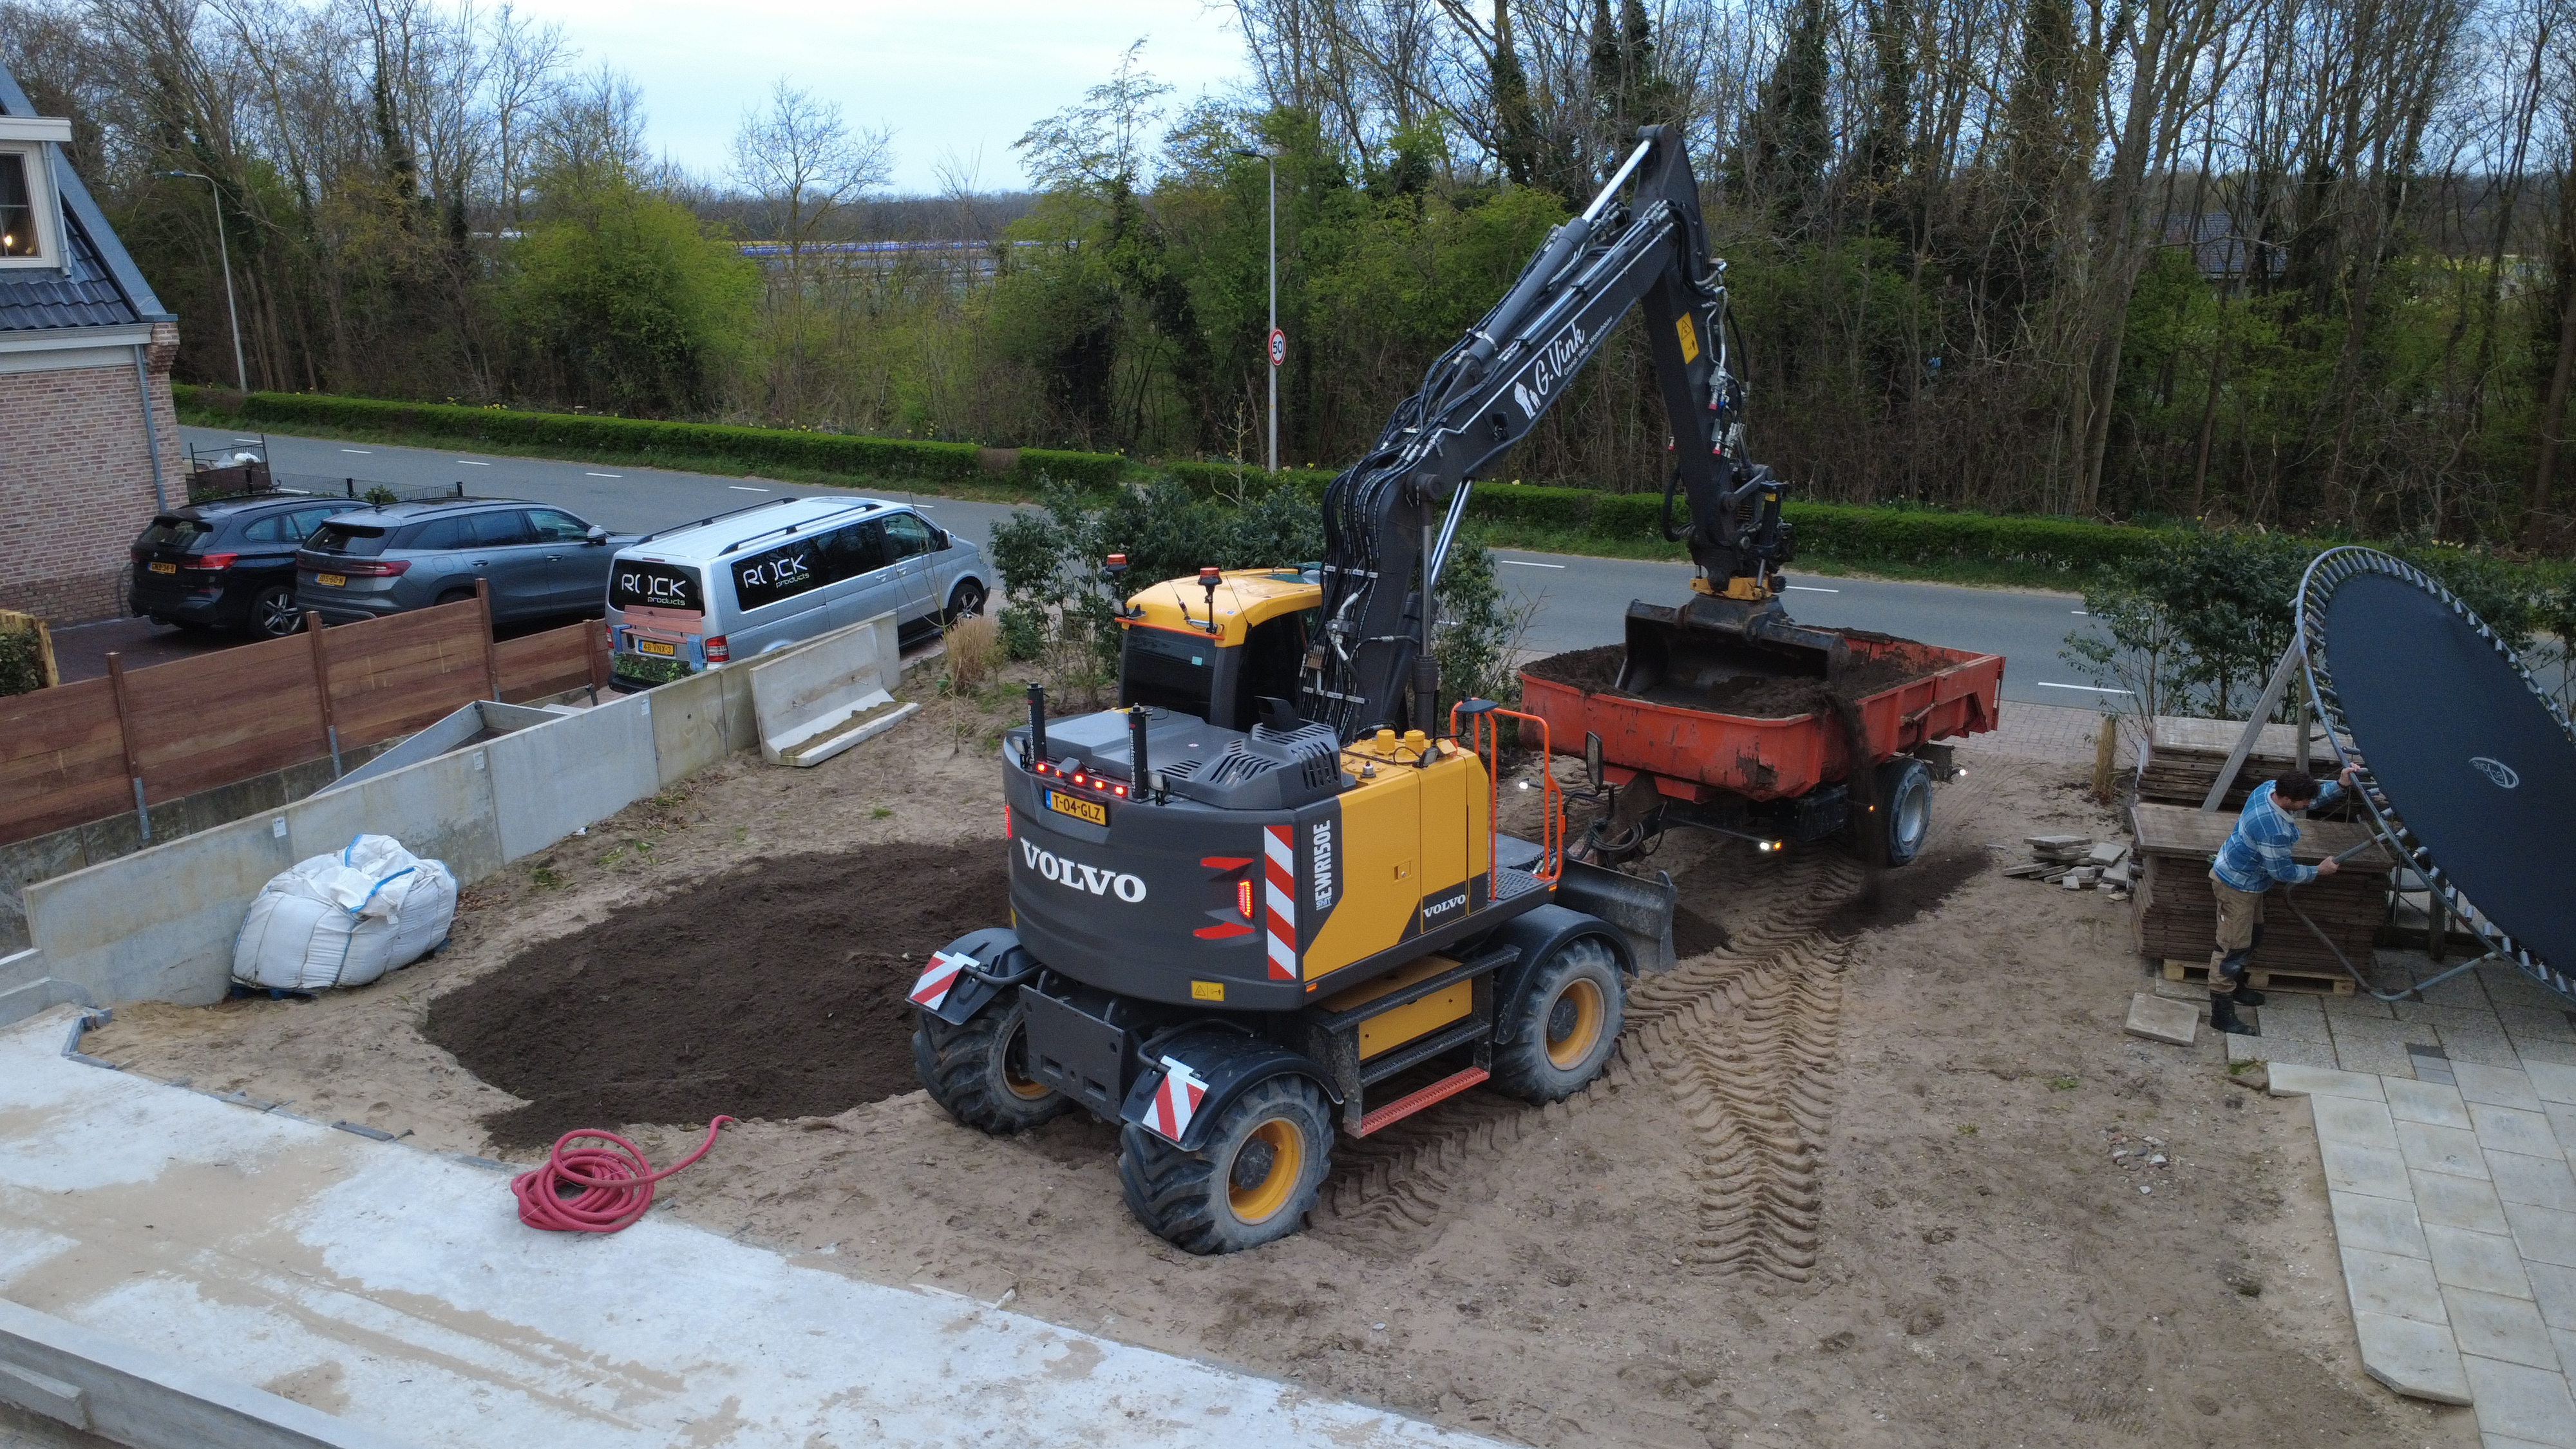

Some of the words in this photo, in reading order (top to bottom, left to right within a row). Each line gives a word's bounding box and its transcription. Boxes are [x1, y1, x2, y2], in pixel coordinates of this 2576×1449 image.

[1273, 340, 1283, 355] 50
[775, 572, 810, 589] products
[647, 596, 686, 606] products
[1054, 795, 1101, 821] T-04-GLZ
[1020, 837, 1147, 903] VOLVO
[1313, 819, 1332, 902] EWR150E
[1423, 894, 1466, 918] VOLVO
